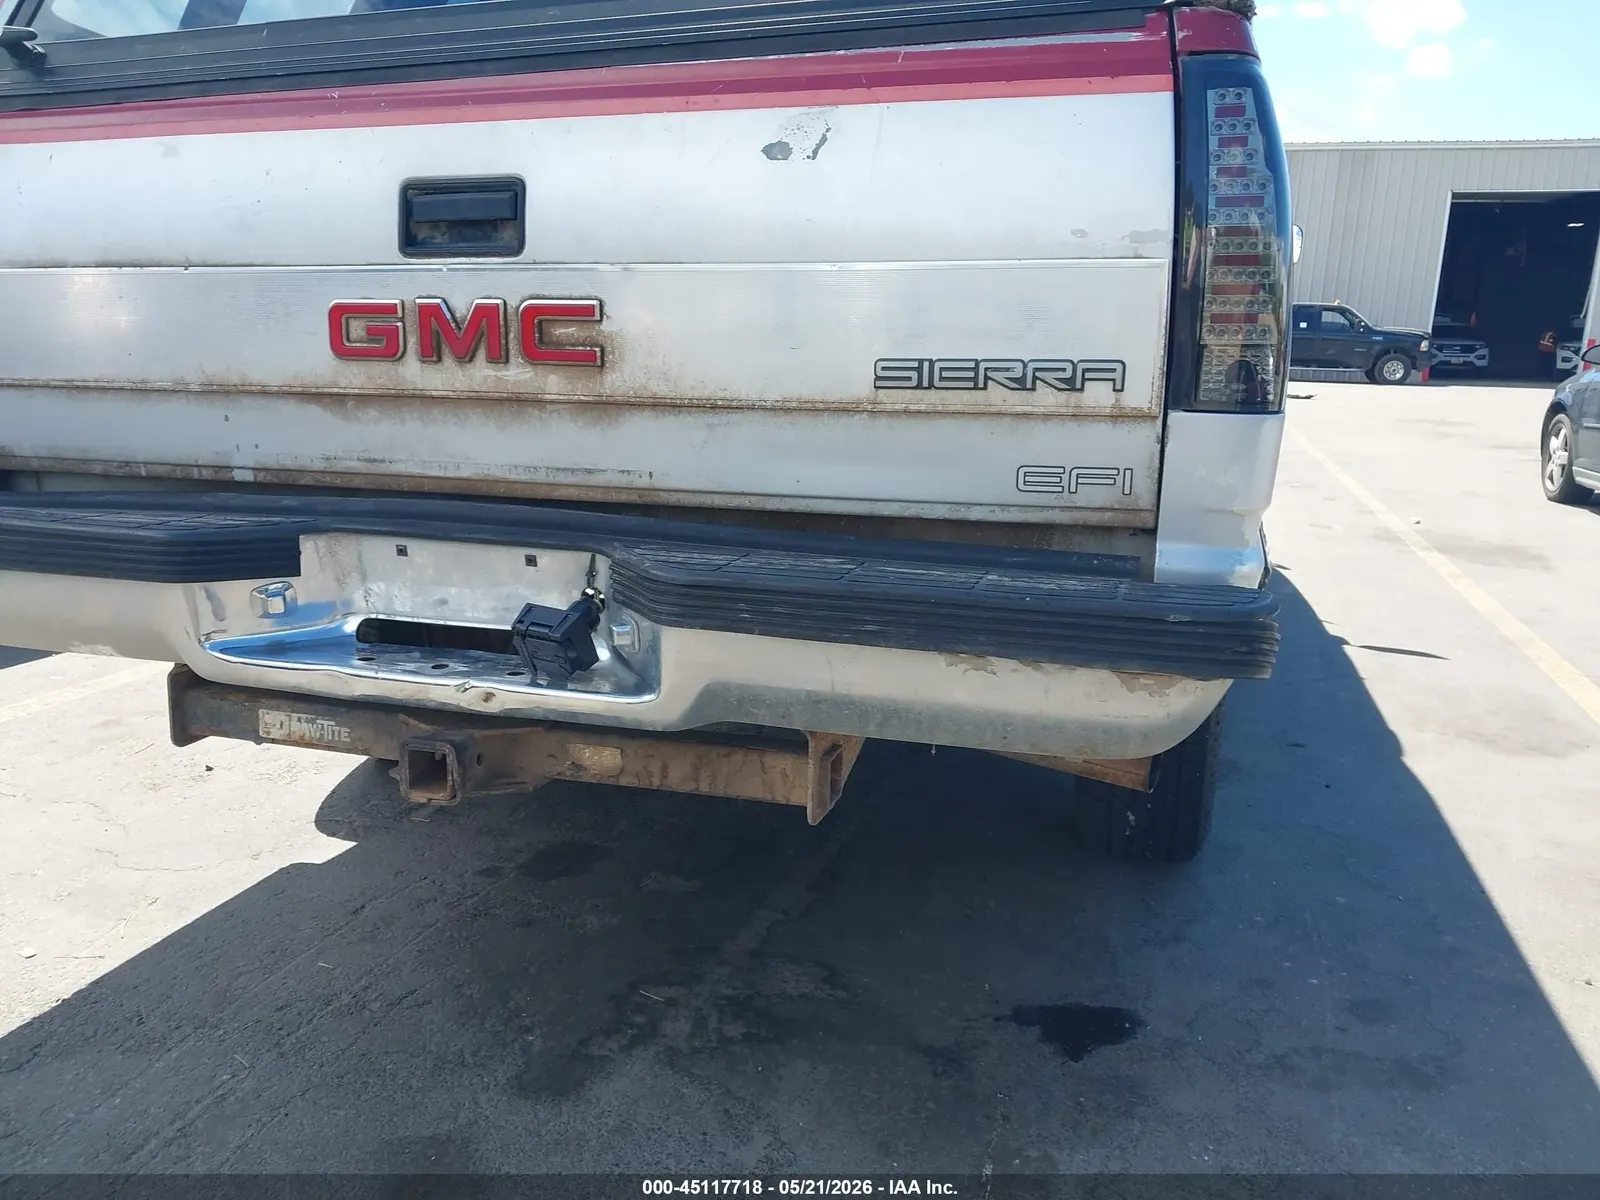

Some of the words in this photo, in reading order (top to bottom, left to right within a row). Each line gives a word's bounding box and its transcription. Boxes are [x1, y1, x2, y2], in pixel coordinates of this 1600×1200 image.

[328, 298, 604, 366] GMC
[874, 358, 1126, 392] SIERRA
[1016, 465, 1133, 495] EFI
